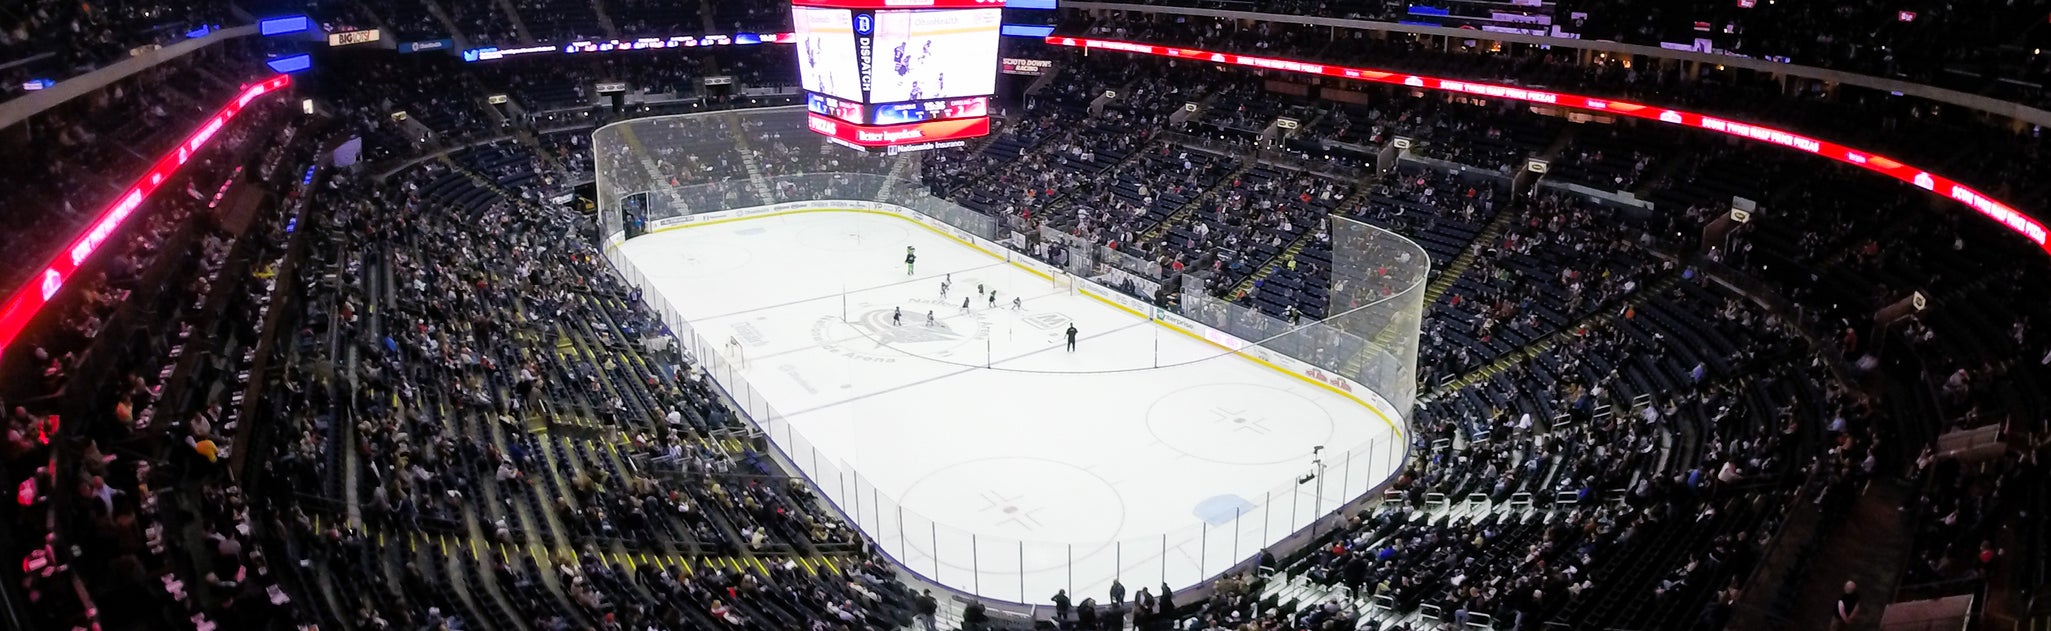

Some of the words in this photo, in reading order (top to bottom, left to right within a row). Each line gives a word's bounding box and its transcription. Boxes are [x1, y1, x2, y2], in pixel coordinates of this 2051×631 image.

[339, 33, 352, 44] BIG
[859, 37, 872, 92] DISPATCH
[1002, 58, 1026, 66] SCIOTO
[1027, 60, 1052, 68] DOWNS
[1527, 92, 1557, 104] PIZZAS
[897, 141, 935, 153] Nationwide
[935, 140, 965, 149] Insurance
